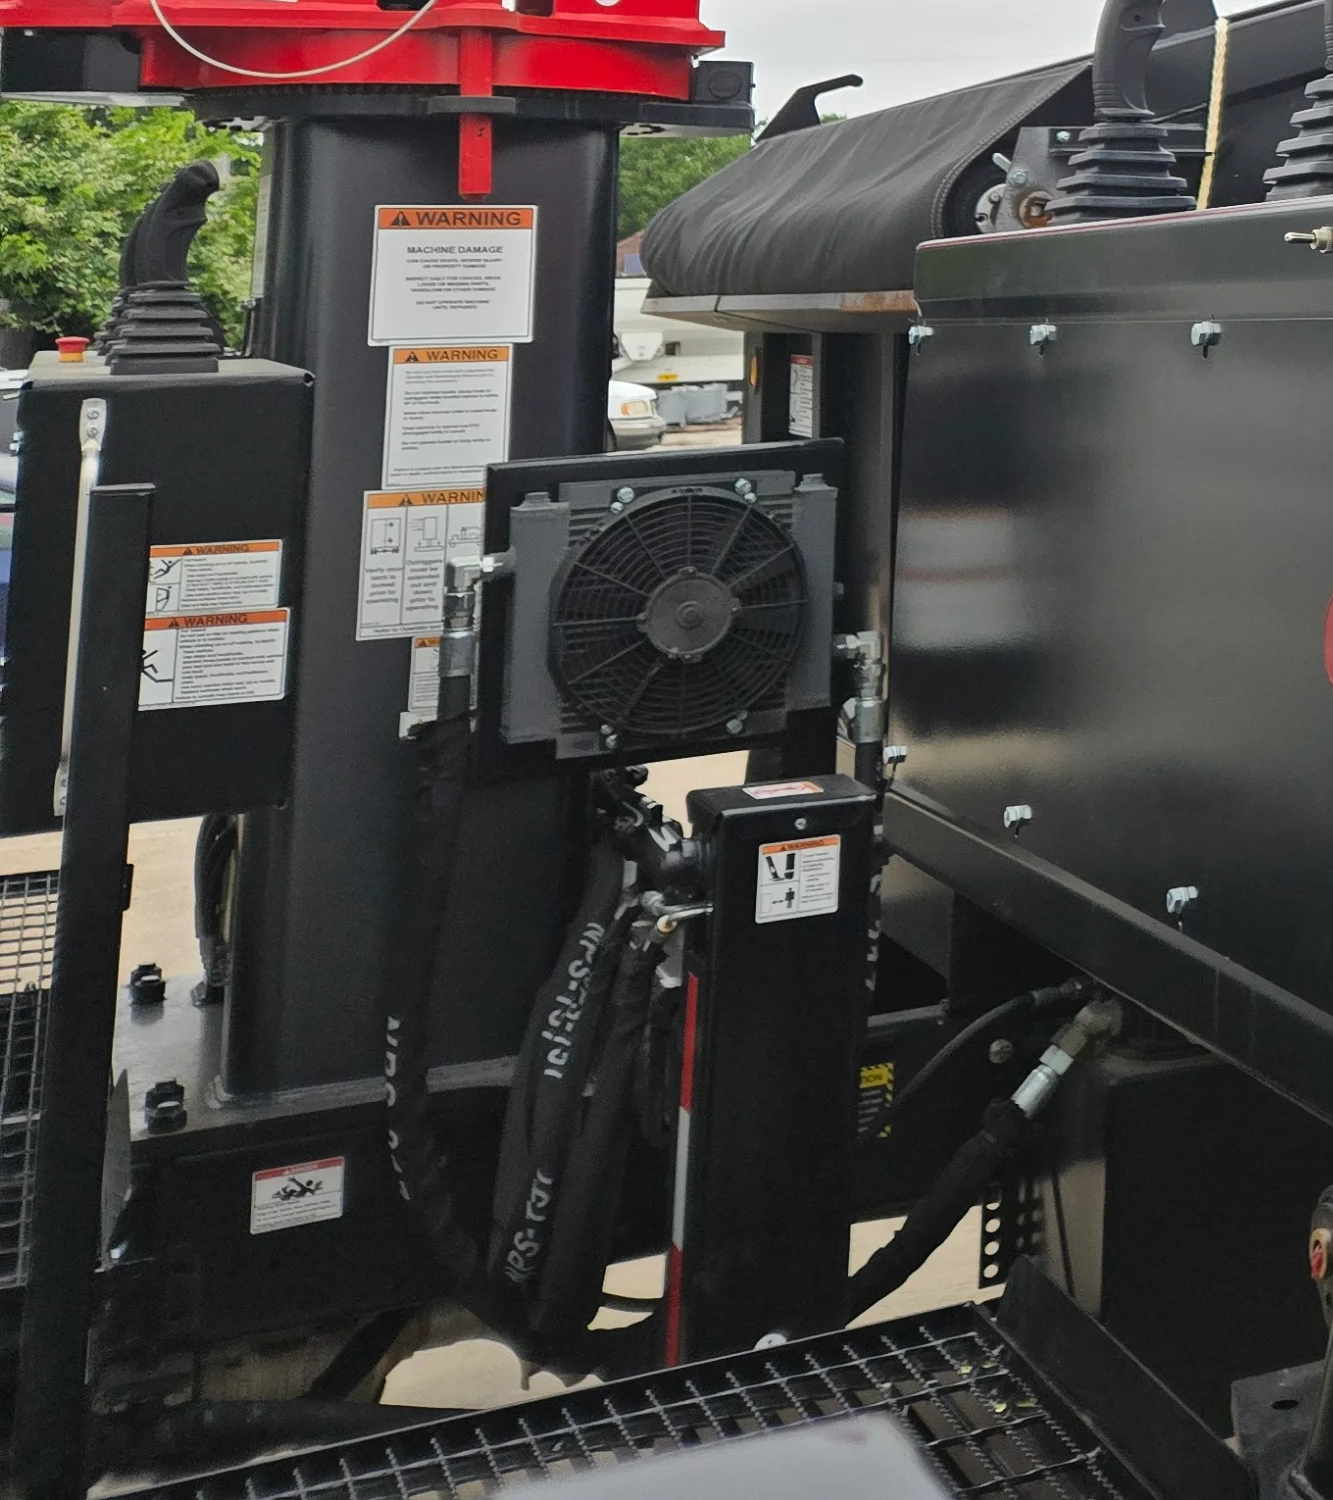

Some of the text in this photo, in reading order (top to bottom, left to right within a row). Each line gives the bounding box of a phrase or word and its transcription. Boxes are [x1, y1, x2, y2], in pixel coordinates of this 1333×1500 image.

[416, 211, 521, 226] WARNING
[407, 246, 504, 254] MACHINE DAMAGE
[426, 349, 498, 360] WARNING
[421, 491, 484, 504] WARNIN
[195, 544, 250, 555] WARNING
[183, 613, 248, 627] WARNING
